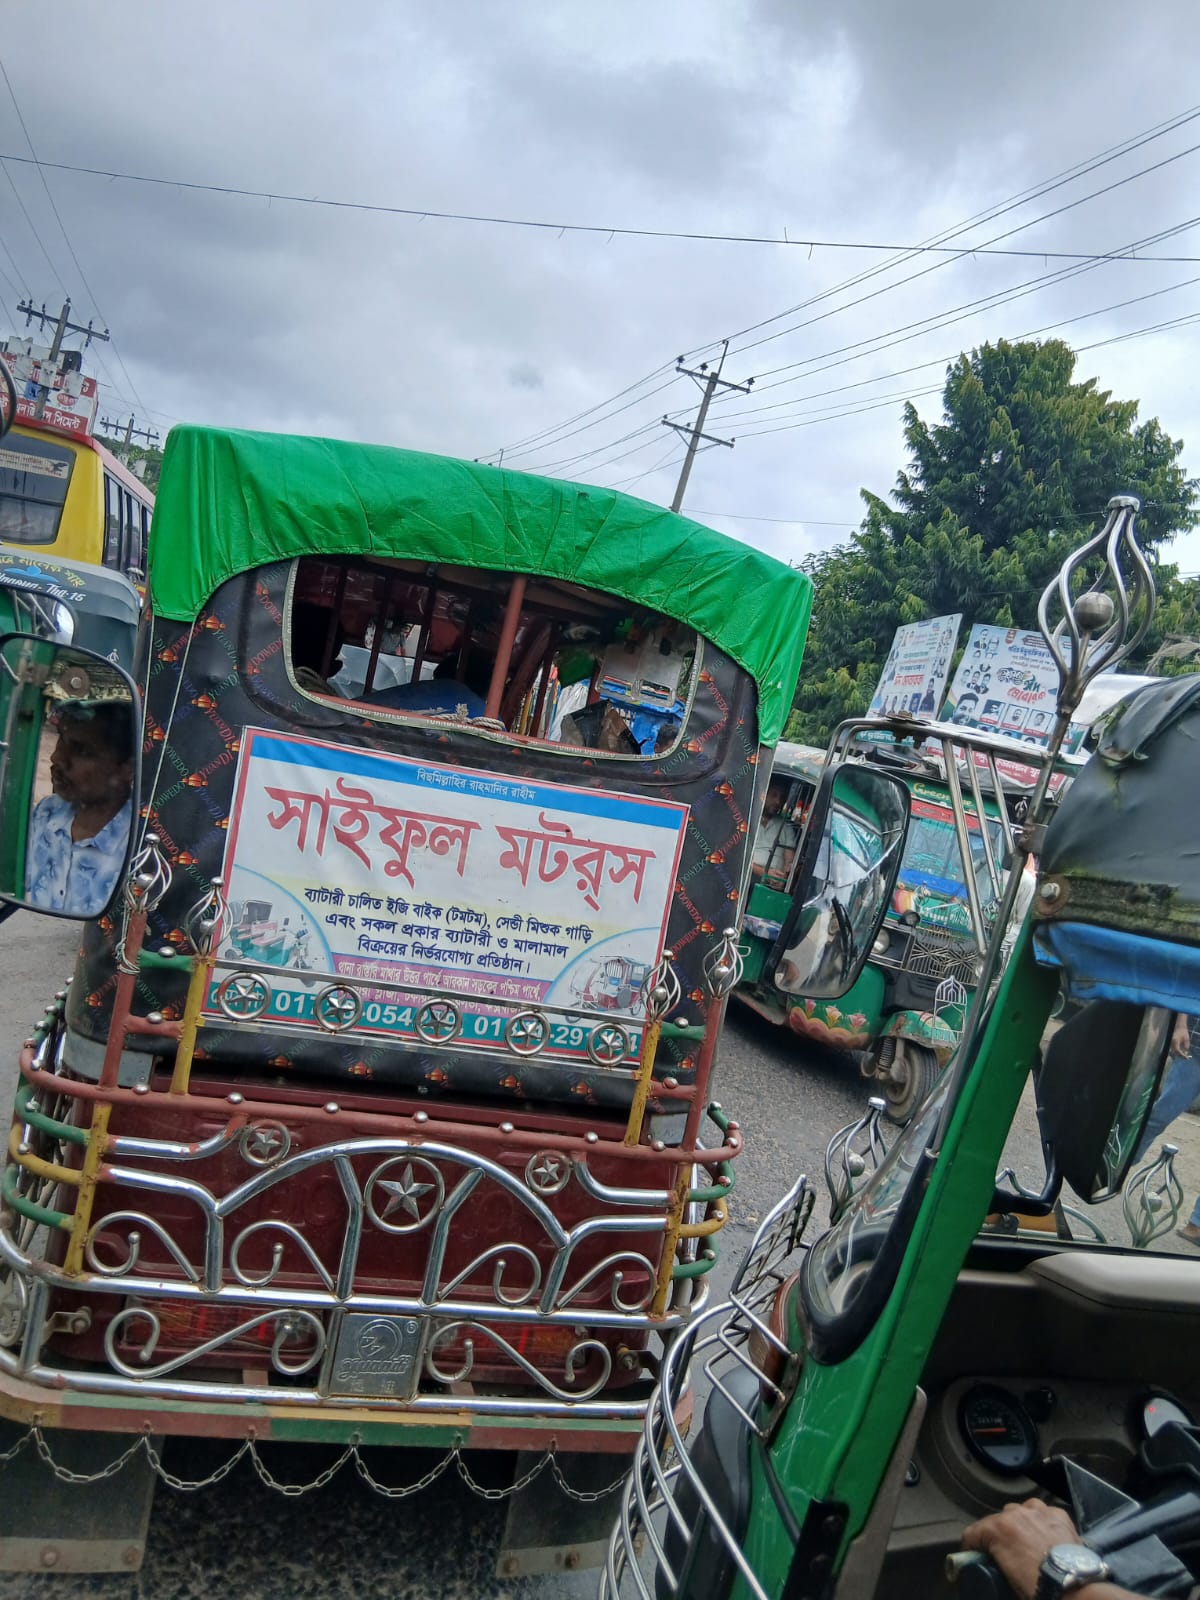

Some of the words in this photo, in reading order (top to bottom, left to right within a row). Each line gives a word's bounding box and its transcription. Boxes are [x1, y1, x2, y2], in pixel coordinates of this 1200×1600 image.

[264, 776, 482, 889] সাইফুল
[304, 886, 345, 905] ব্যাটারী
[348, 891, 383, 910] চালিত
[386, 895, 410, 915] ইজি
[413, 900, 443, 920] বাইক
[526, 916, 562, 936] মিশুক
[565, 923, 593, 944] গাড়ি
[325, 912, 356, 930] এবং
[361, 917, 398, 934] সকল
[401, 922, 441, 940] প্রকার
[445, 927, 493, 948] ব্যাটারী
[497, 937, 509, 949] ও
[513, 938, 569, 959] মালামাল
[358, 934, 408, 957] বিক্রয়ের
[411, 941, 475, 966] নির্ভরযোগ্য
